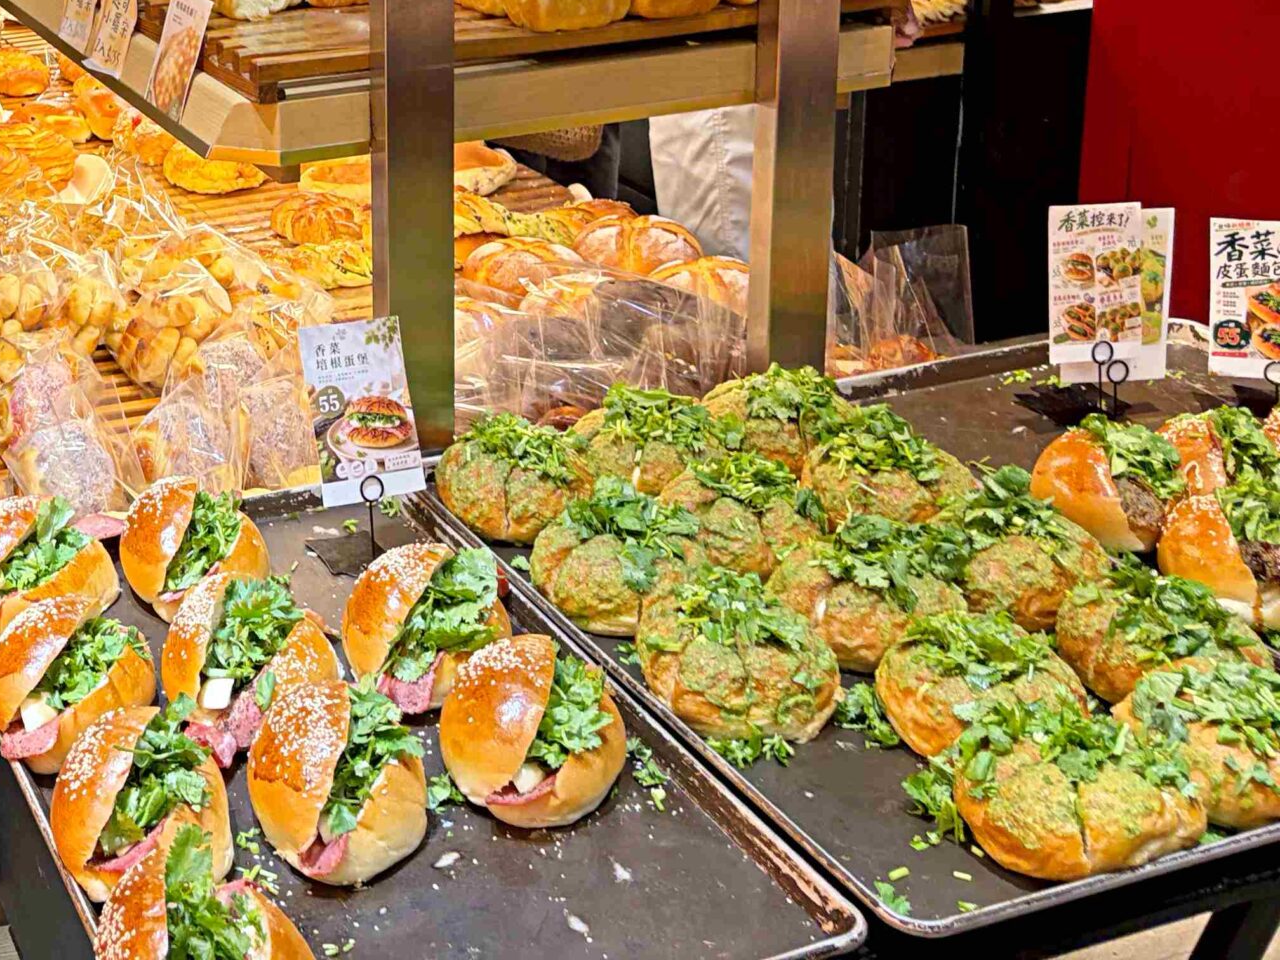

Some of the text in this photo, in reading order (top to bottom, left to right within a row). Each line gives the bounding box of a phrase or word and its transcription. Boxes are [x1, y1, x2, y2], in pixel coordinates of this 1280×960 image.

[1214, 230, 1280, 262] 香菜
[1217, 327, 1241, 346] 55
[315, 341, 340, 358] 香菜
[319, 393, 341, 413] 55
